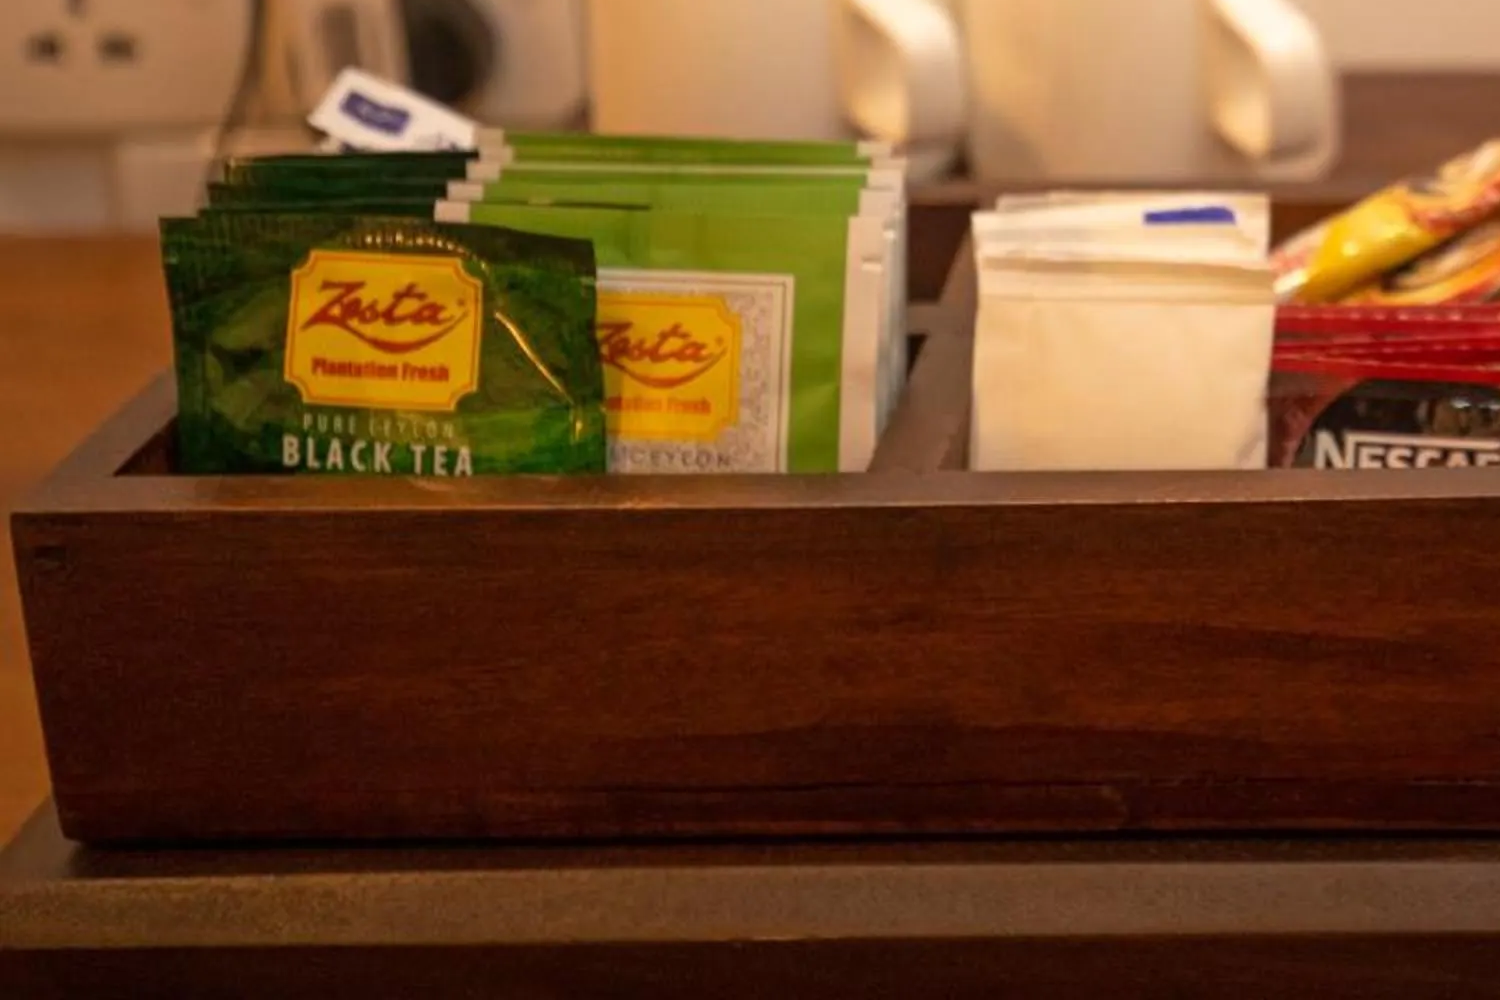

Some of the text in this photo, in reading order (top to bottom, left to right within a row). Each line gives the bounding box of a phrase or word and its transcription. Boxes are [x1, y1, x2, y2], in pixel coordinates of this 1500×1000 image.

[302, 279, 468, 350] Zesta
[311, 356, 451, 382] Plantation Fresh
[282, 434, 473, 476] BLACK TEA
